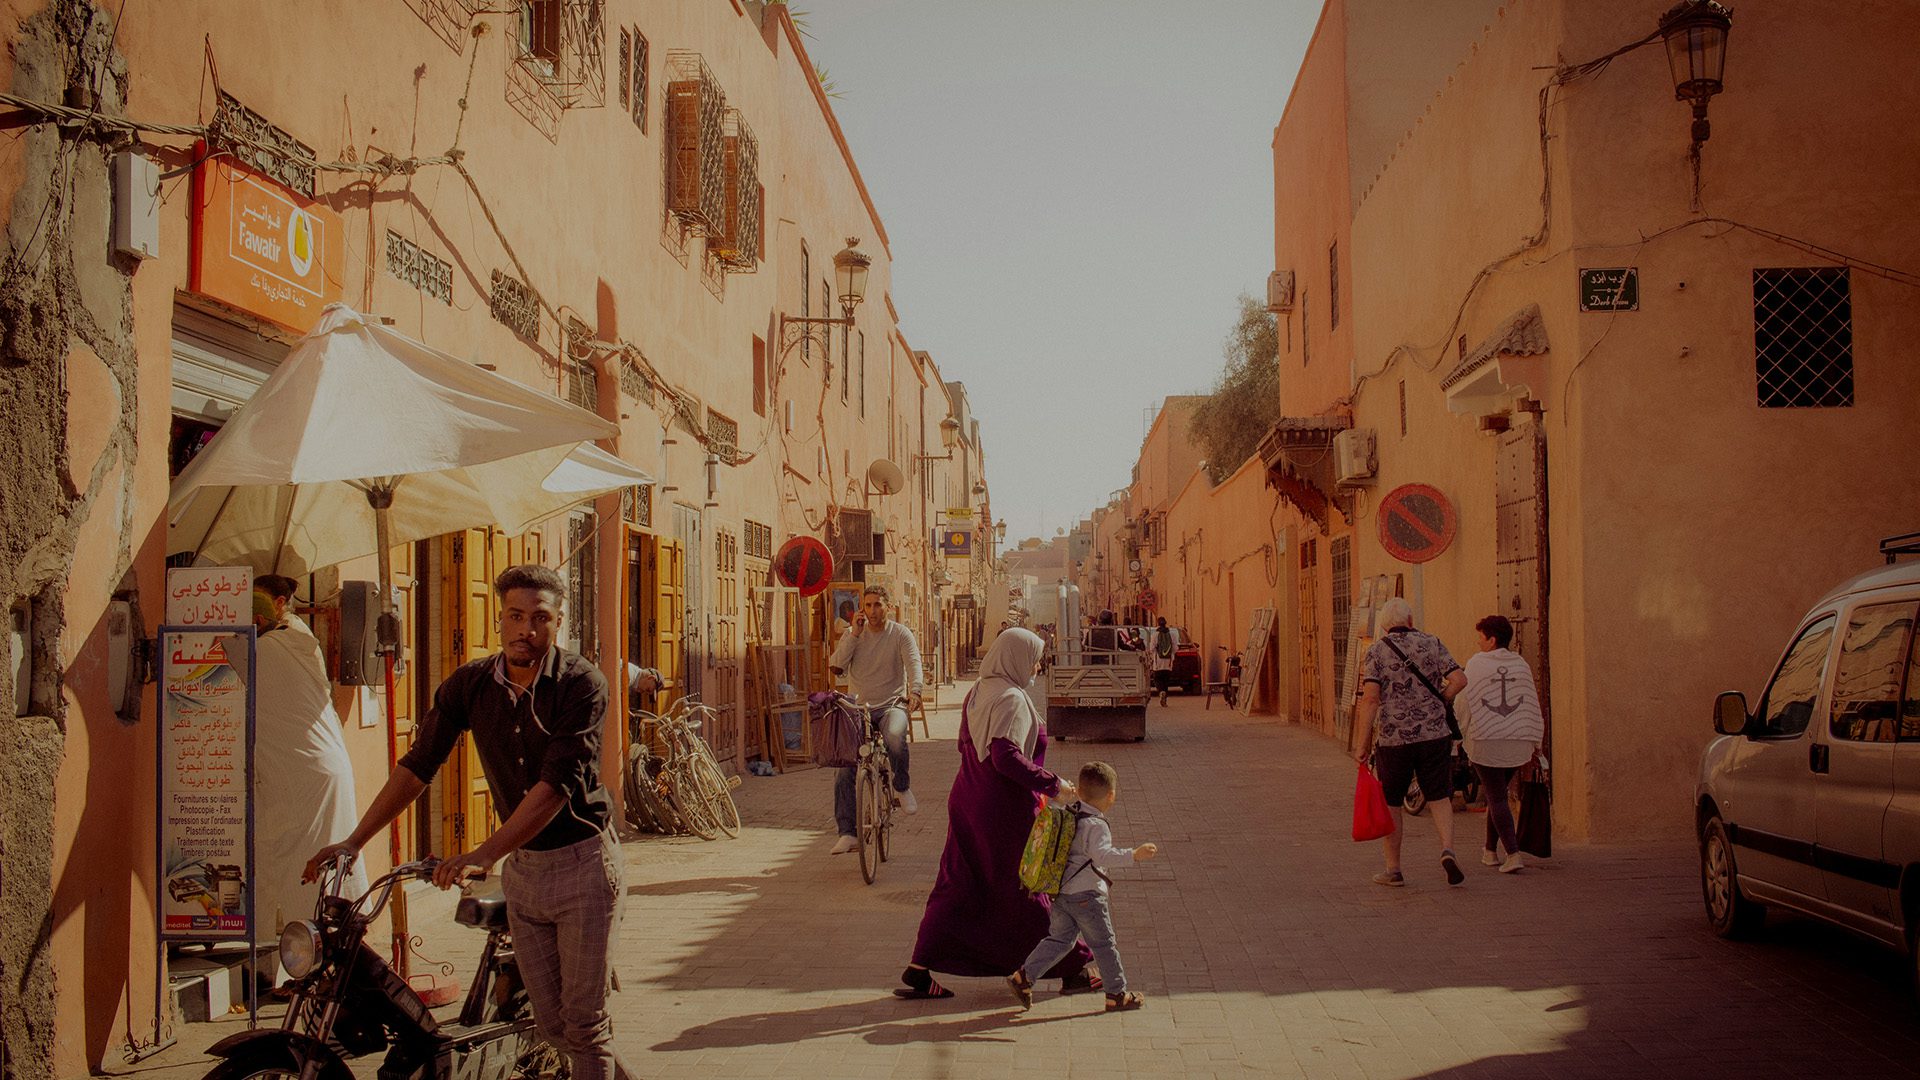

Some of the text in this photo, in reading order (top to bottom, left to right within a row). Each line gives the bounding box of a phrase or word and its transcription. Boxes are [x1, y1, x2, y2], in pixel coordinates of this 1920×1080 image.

[242, 204, 281, 229] فواتير
[239, 221, 281, 263] Fawatir
[172, 574, 248, 601] فوطوكوبي
[172, 636, 230, 673] كتبة
[173, 794, 209, 804] Fournitures
[180, 805, 215, 815] Photocopie
[219, 805, 231, 814] Fax
[168, 816, 199, 826] Impression
[200, 817, 210, 825] sur
[185, 826, 225, 836] Plastification
[176, 837, 235, 847] Traitement de texte
[180, 848, 231, 858] Timbres postaux
[220, 918, 244, 927] inwi
